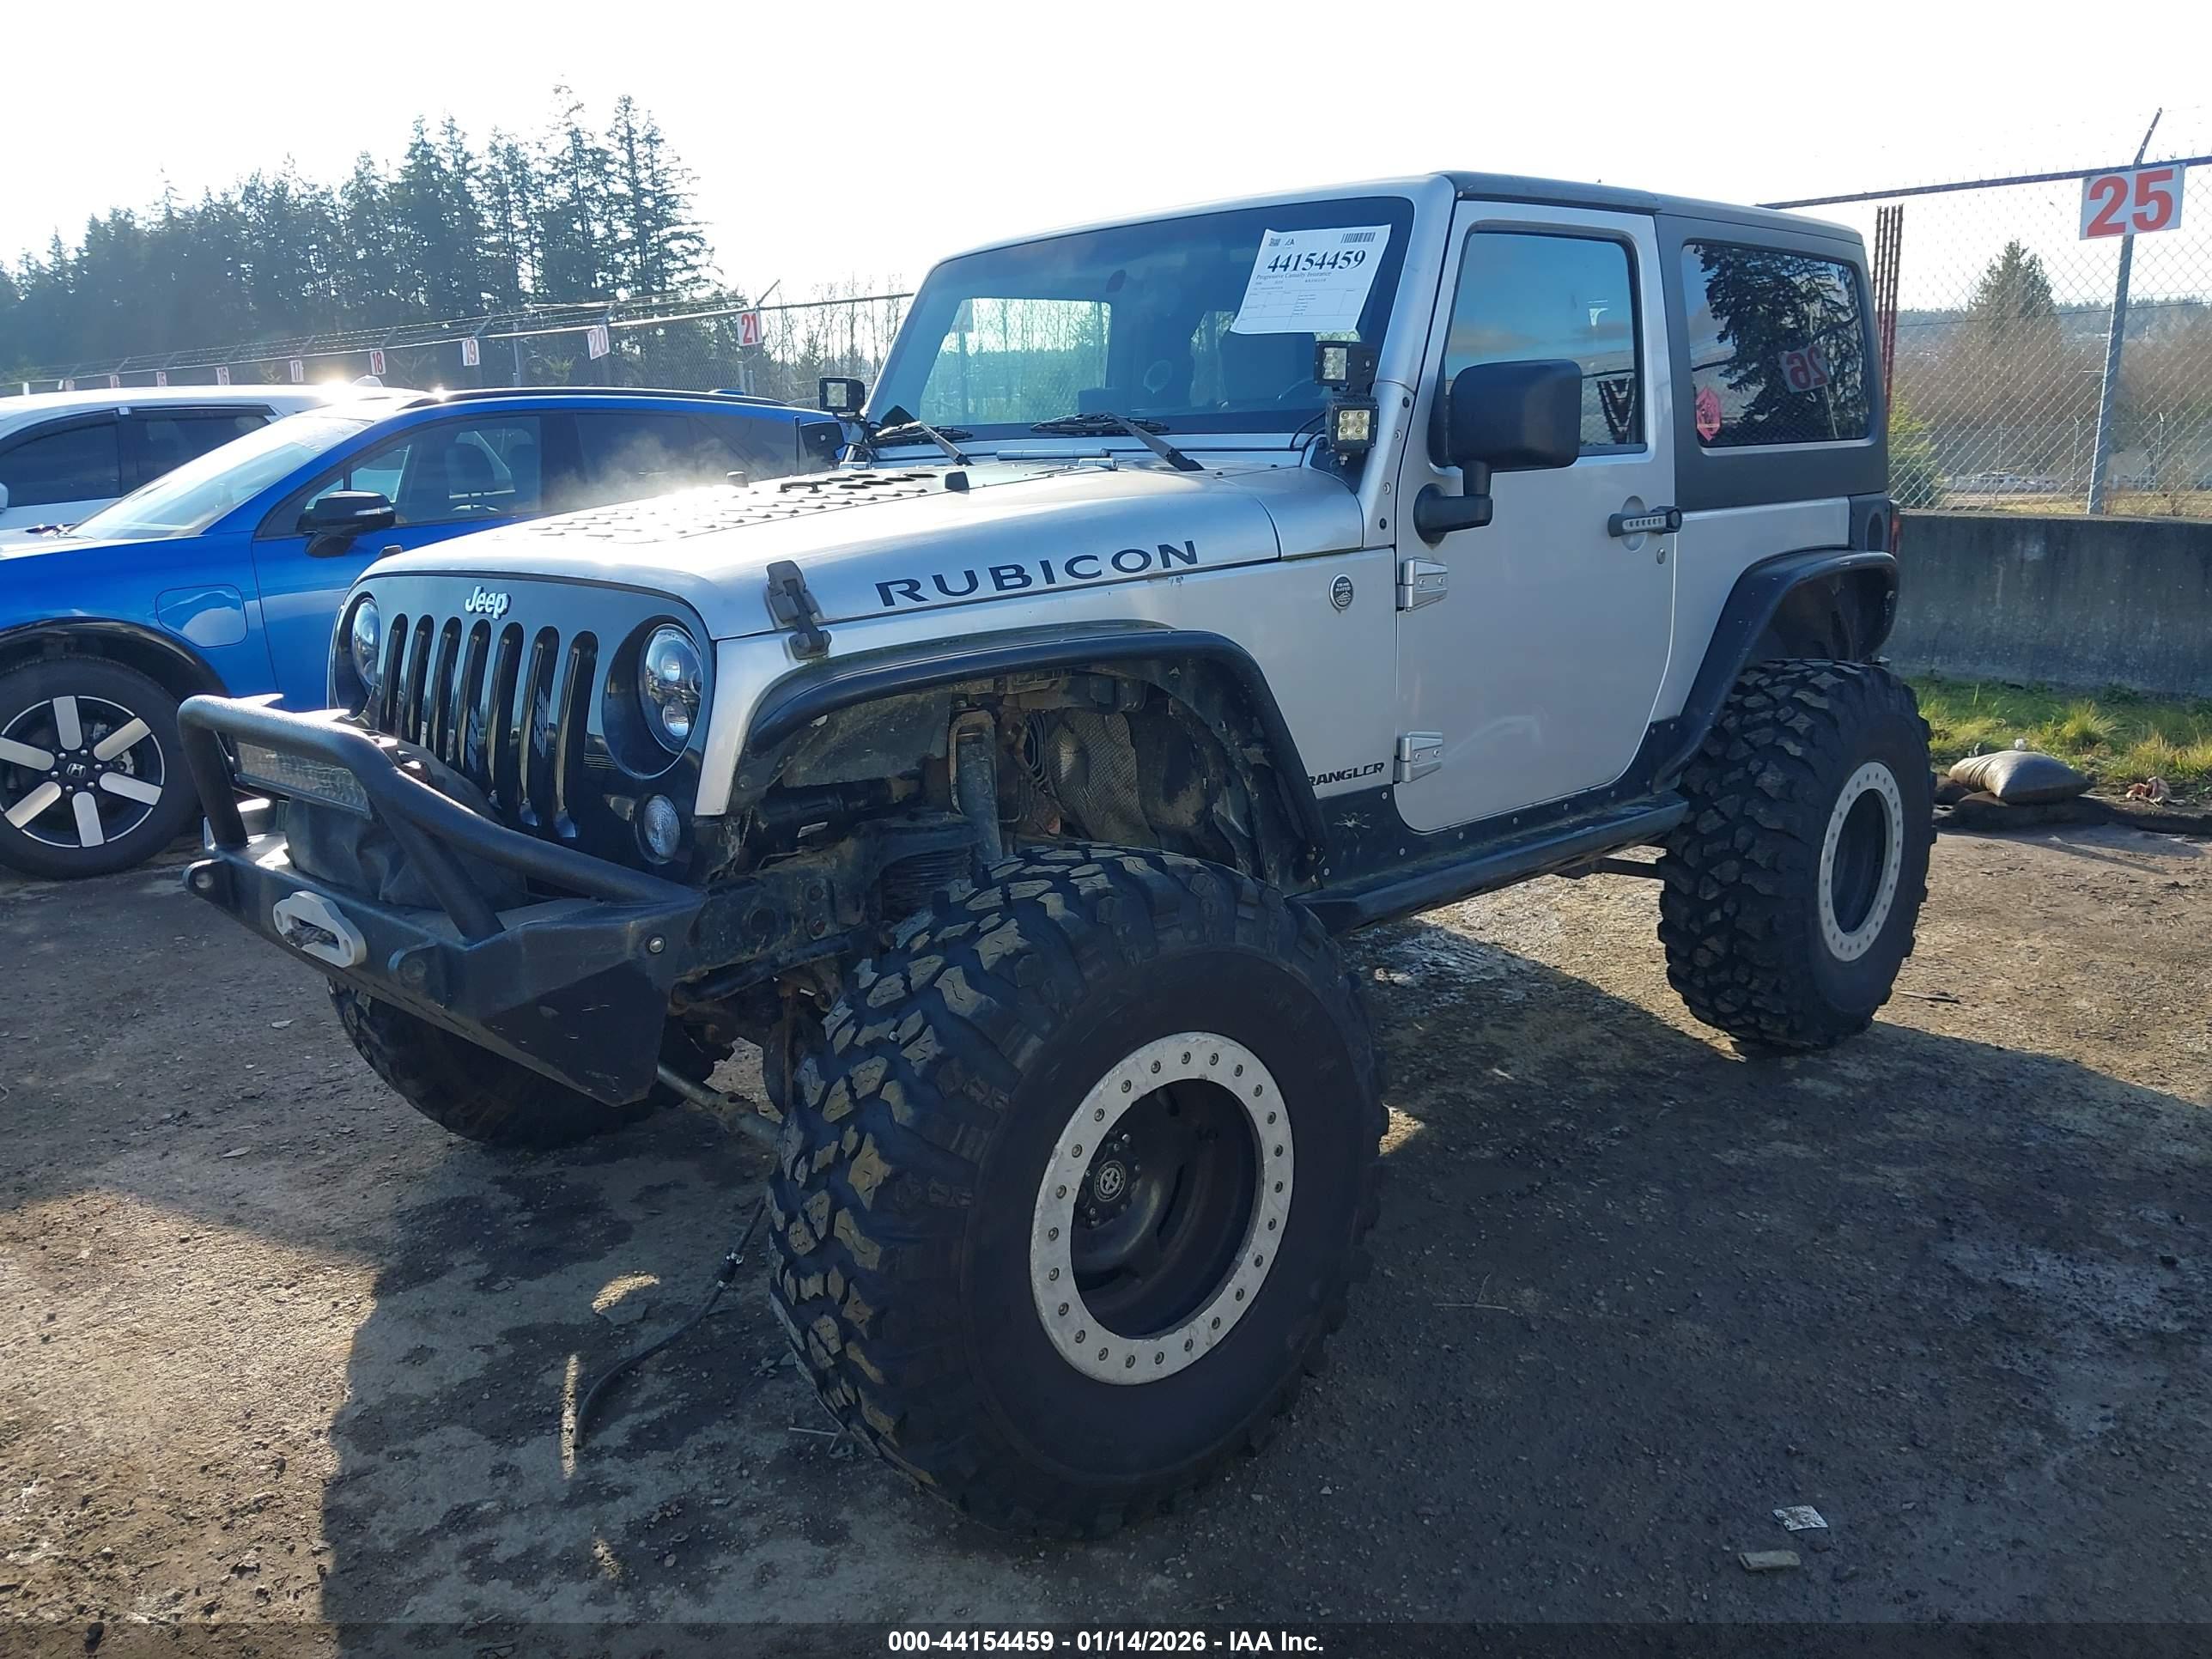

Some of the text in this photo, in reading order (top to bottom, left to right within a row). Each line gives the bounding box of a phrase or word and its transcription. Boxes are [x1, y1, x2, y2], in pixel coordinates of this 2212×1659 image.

[2087, 169, 2172, 237] 25
[1267, 250, 1366, 272] 44154459
[589, 328, 607, 356] 20
[741, 313, 759, 343] 21
[373, 351, 383, 374] 18
[466, 340, 477, 365] 19
[875, 540, 1199, 607] RUBICON
[465, 586, 508, 619] Jeep
[1310, 762, 1385, 787] RANGLER
